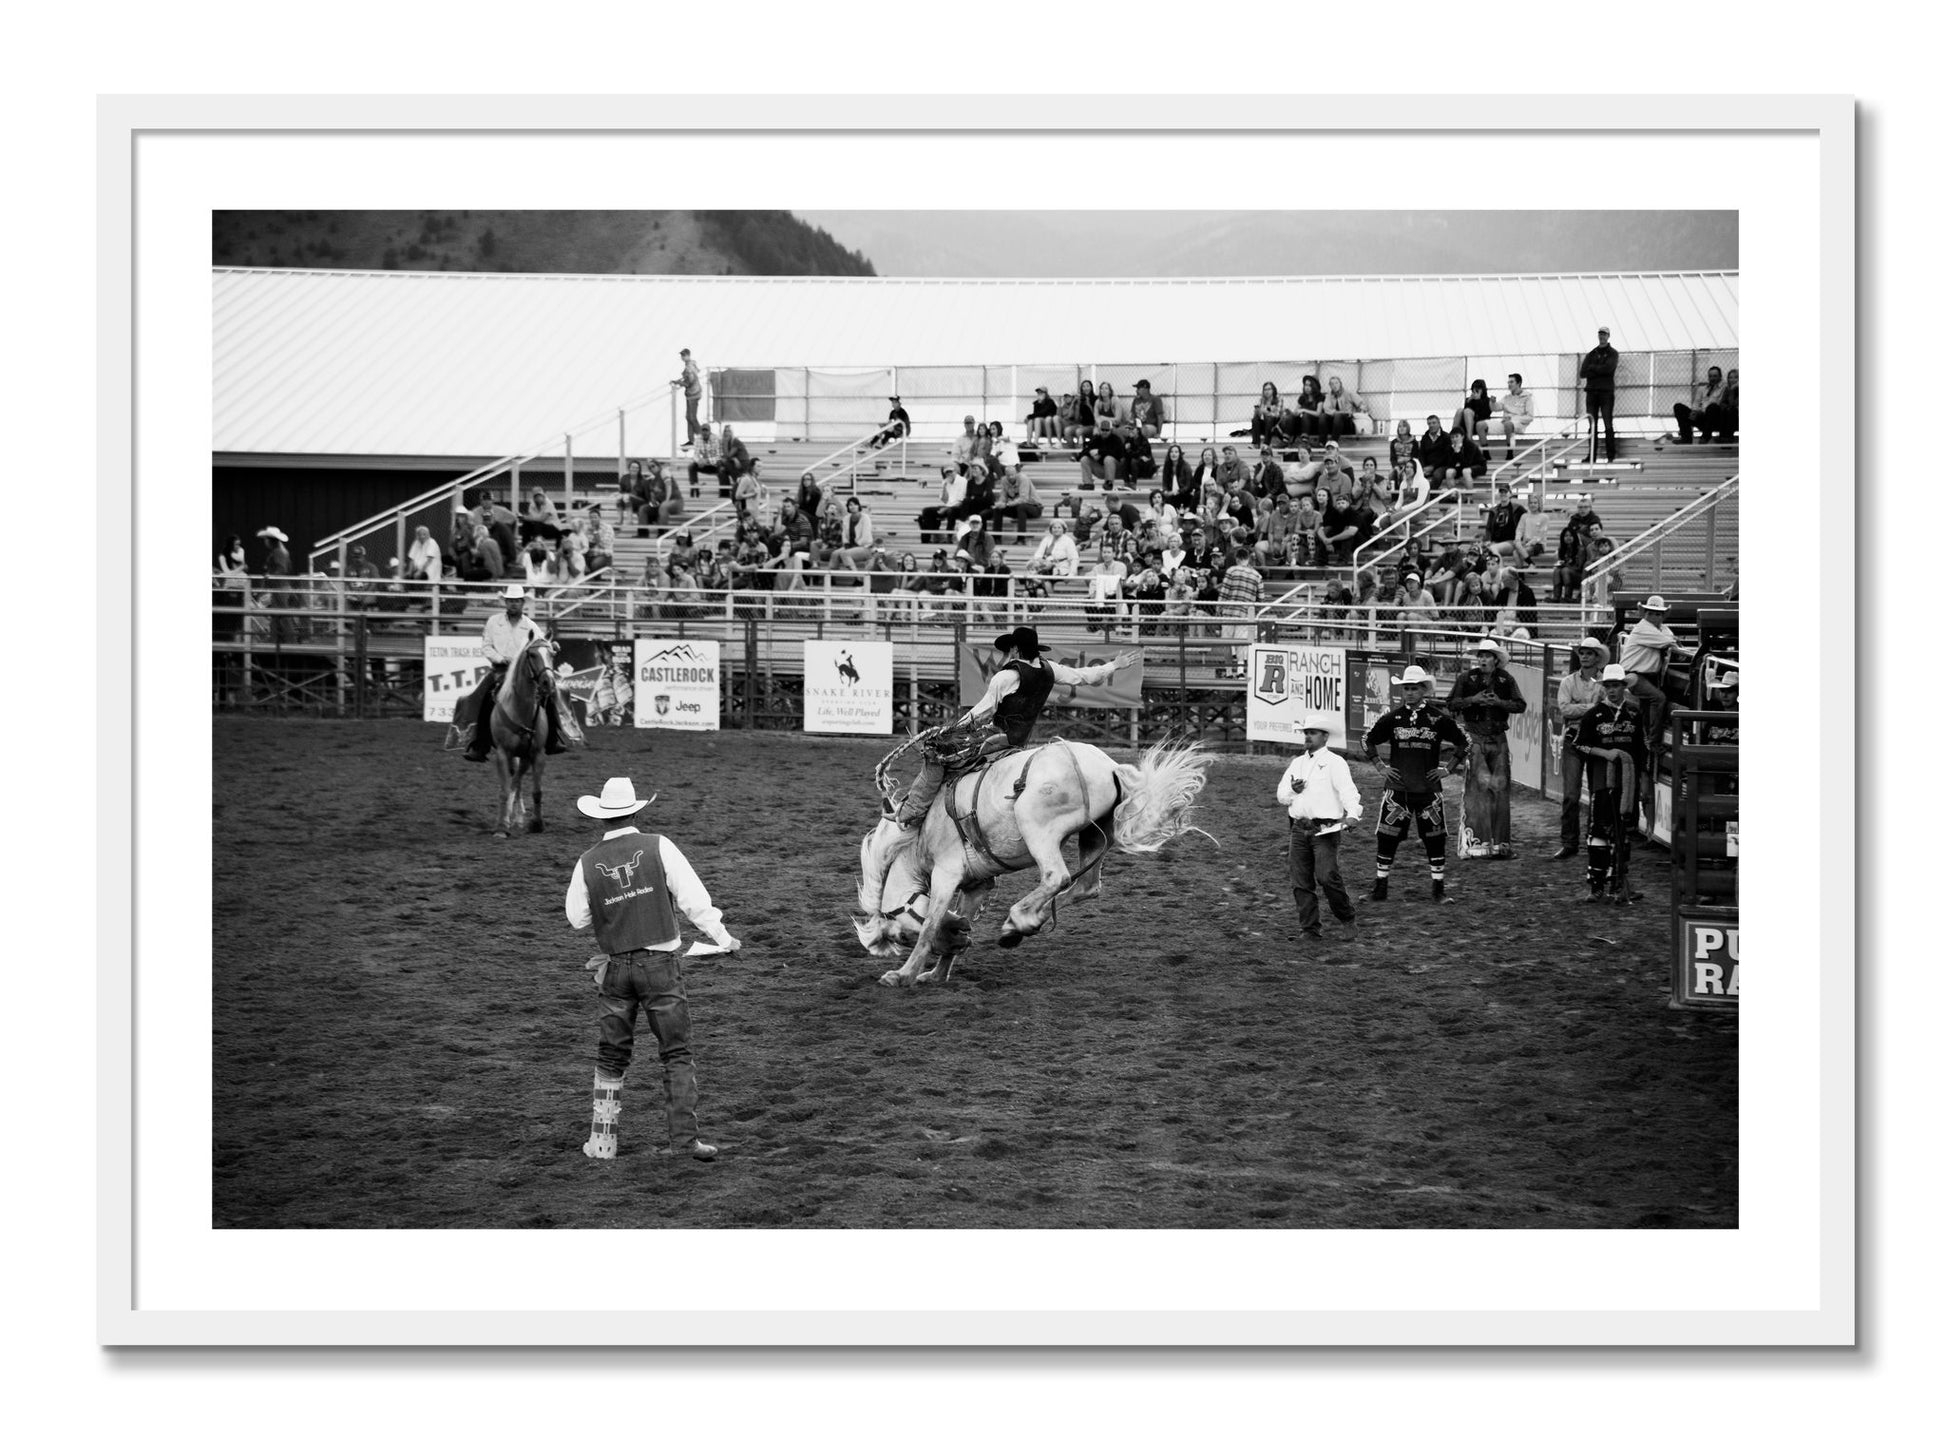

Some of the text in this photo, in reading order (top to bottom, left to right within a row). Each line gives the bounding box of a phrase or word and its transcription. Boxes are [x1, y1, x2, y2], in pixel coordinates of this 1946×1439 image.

[1289, 651, 1341, 675] RANCH
[641, 667, 715, 683] CASTLEROCK
[1259, 664, 1286, 694] R
[806, 687, 891, 698] SNAKE RIVER
[1305, 675, 1342, 712] HOME
[676, 701, 701, 714] Jeep
[836, 707, 854, 717] Well
[635, 886, 654, 895] Rodeo
